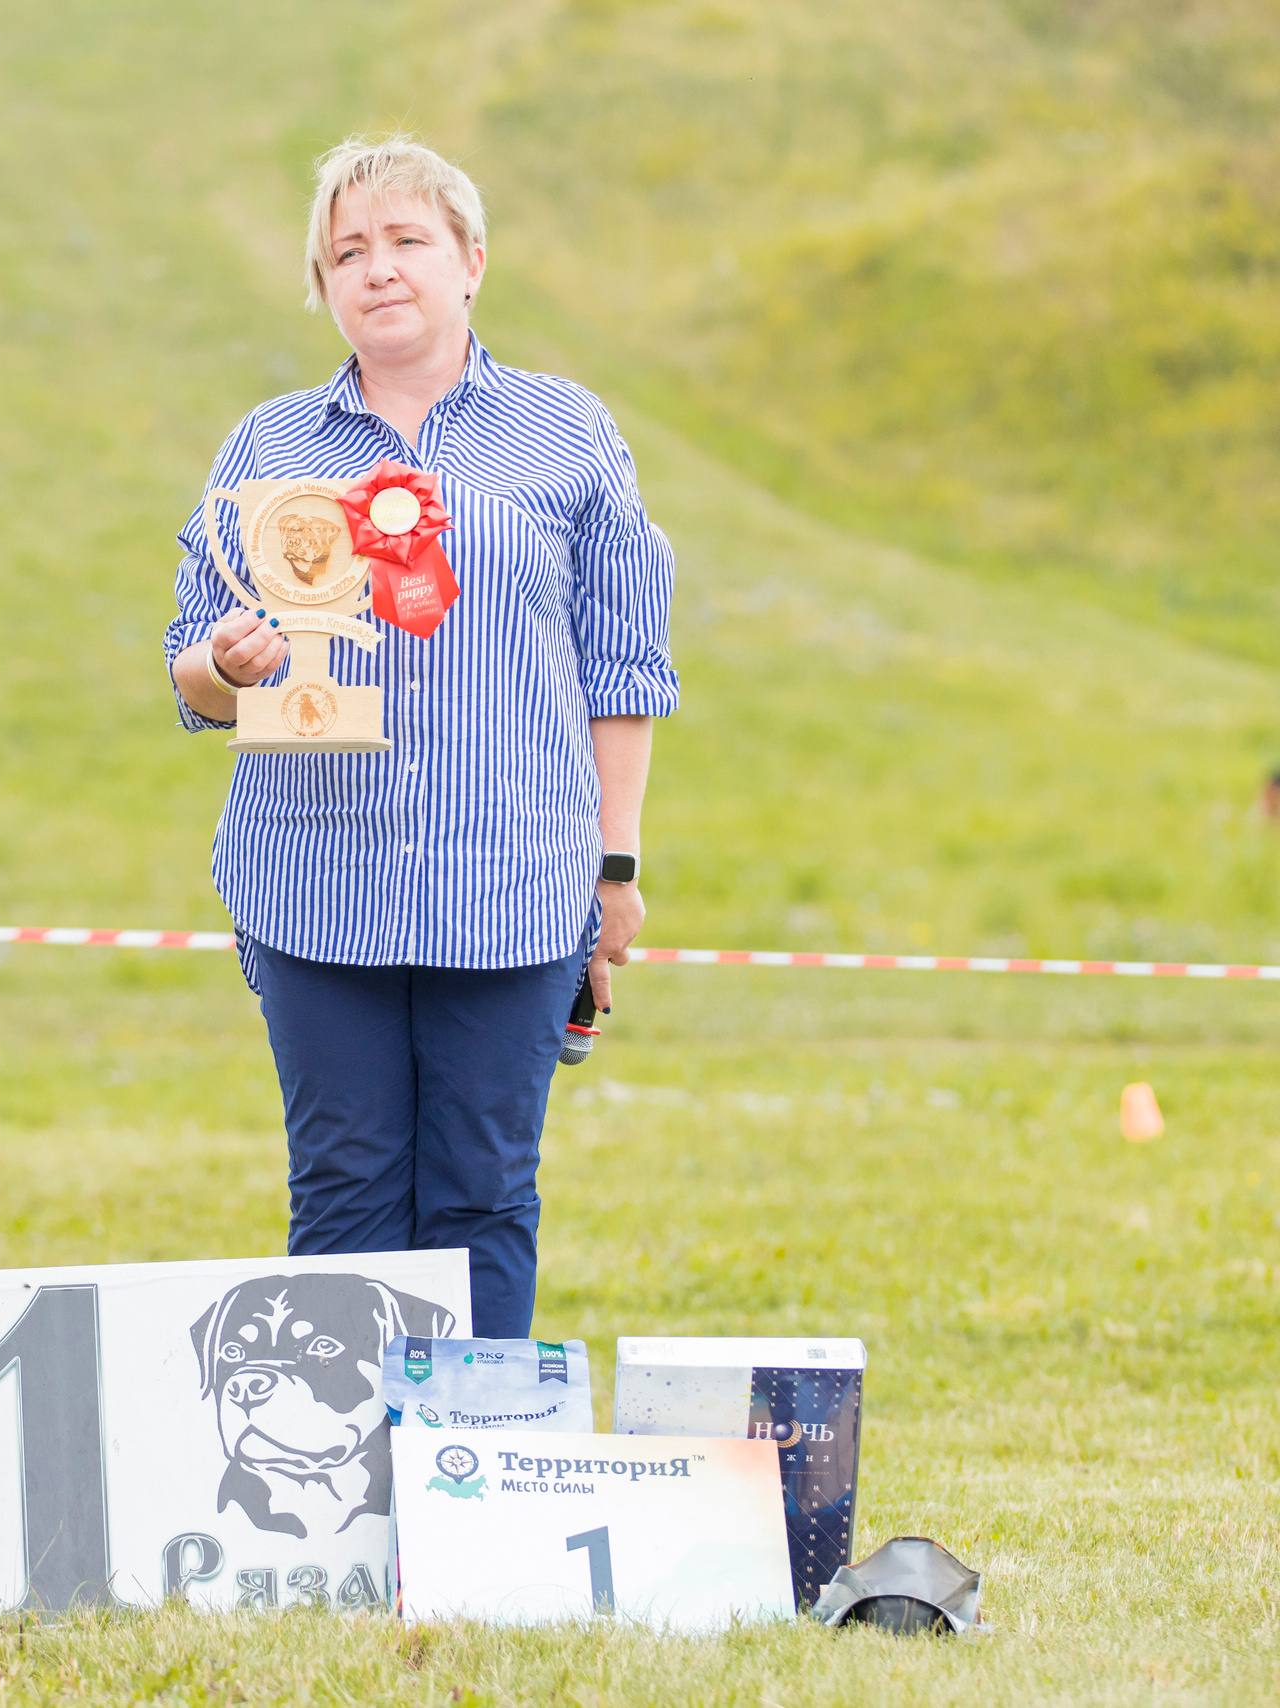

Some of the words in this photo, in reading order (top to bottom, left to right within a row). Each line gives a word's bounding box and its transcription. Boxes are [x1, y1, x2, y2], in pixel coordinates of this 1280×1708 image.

[251, 484, 302, 552] Межрегиональный
[400, 573, 426, 589] Best
[292, 590, 330, 602] Рязани
[397, 583, 435, 604] puppy
[279, 617, 323, 628] едитель
[326, 616, 363, 636] Класса
[409, 1350, 427, 1359] 80%
[476, 1352, 505, 1360] ЭКО
[541, 1350, 564, 1359] 100%
[566, 1525, 616, 1615] 1
